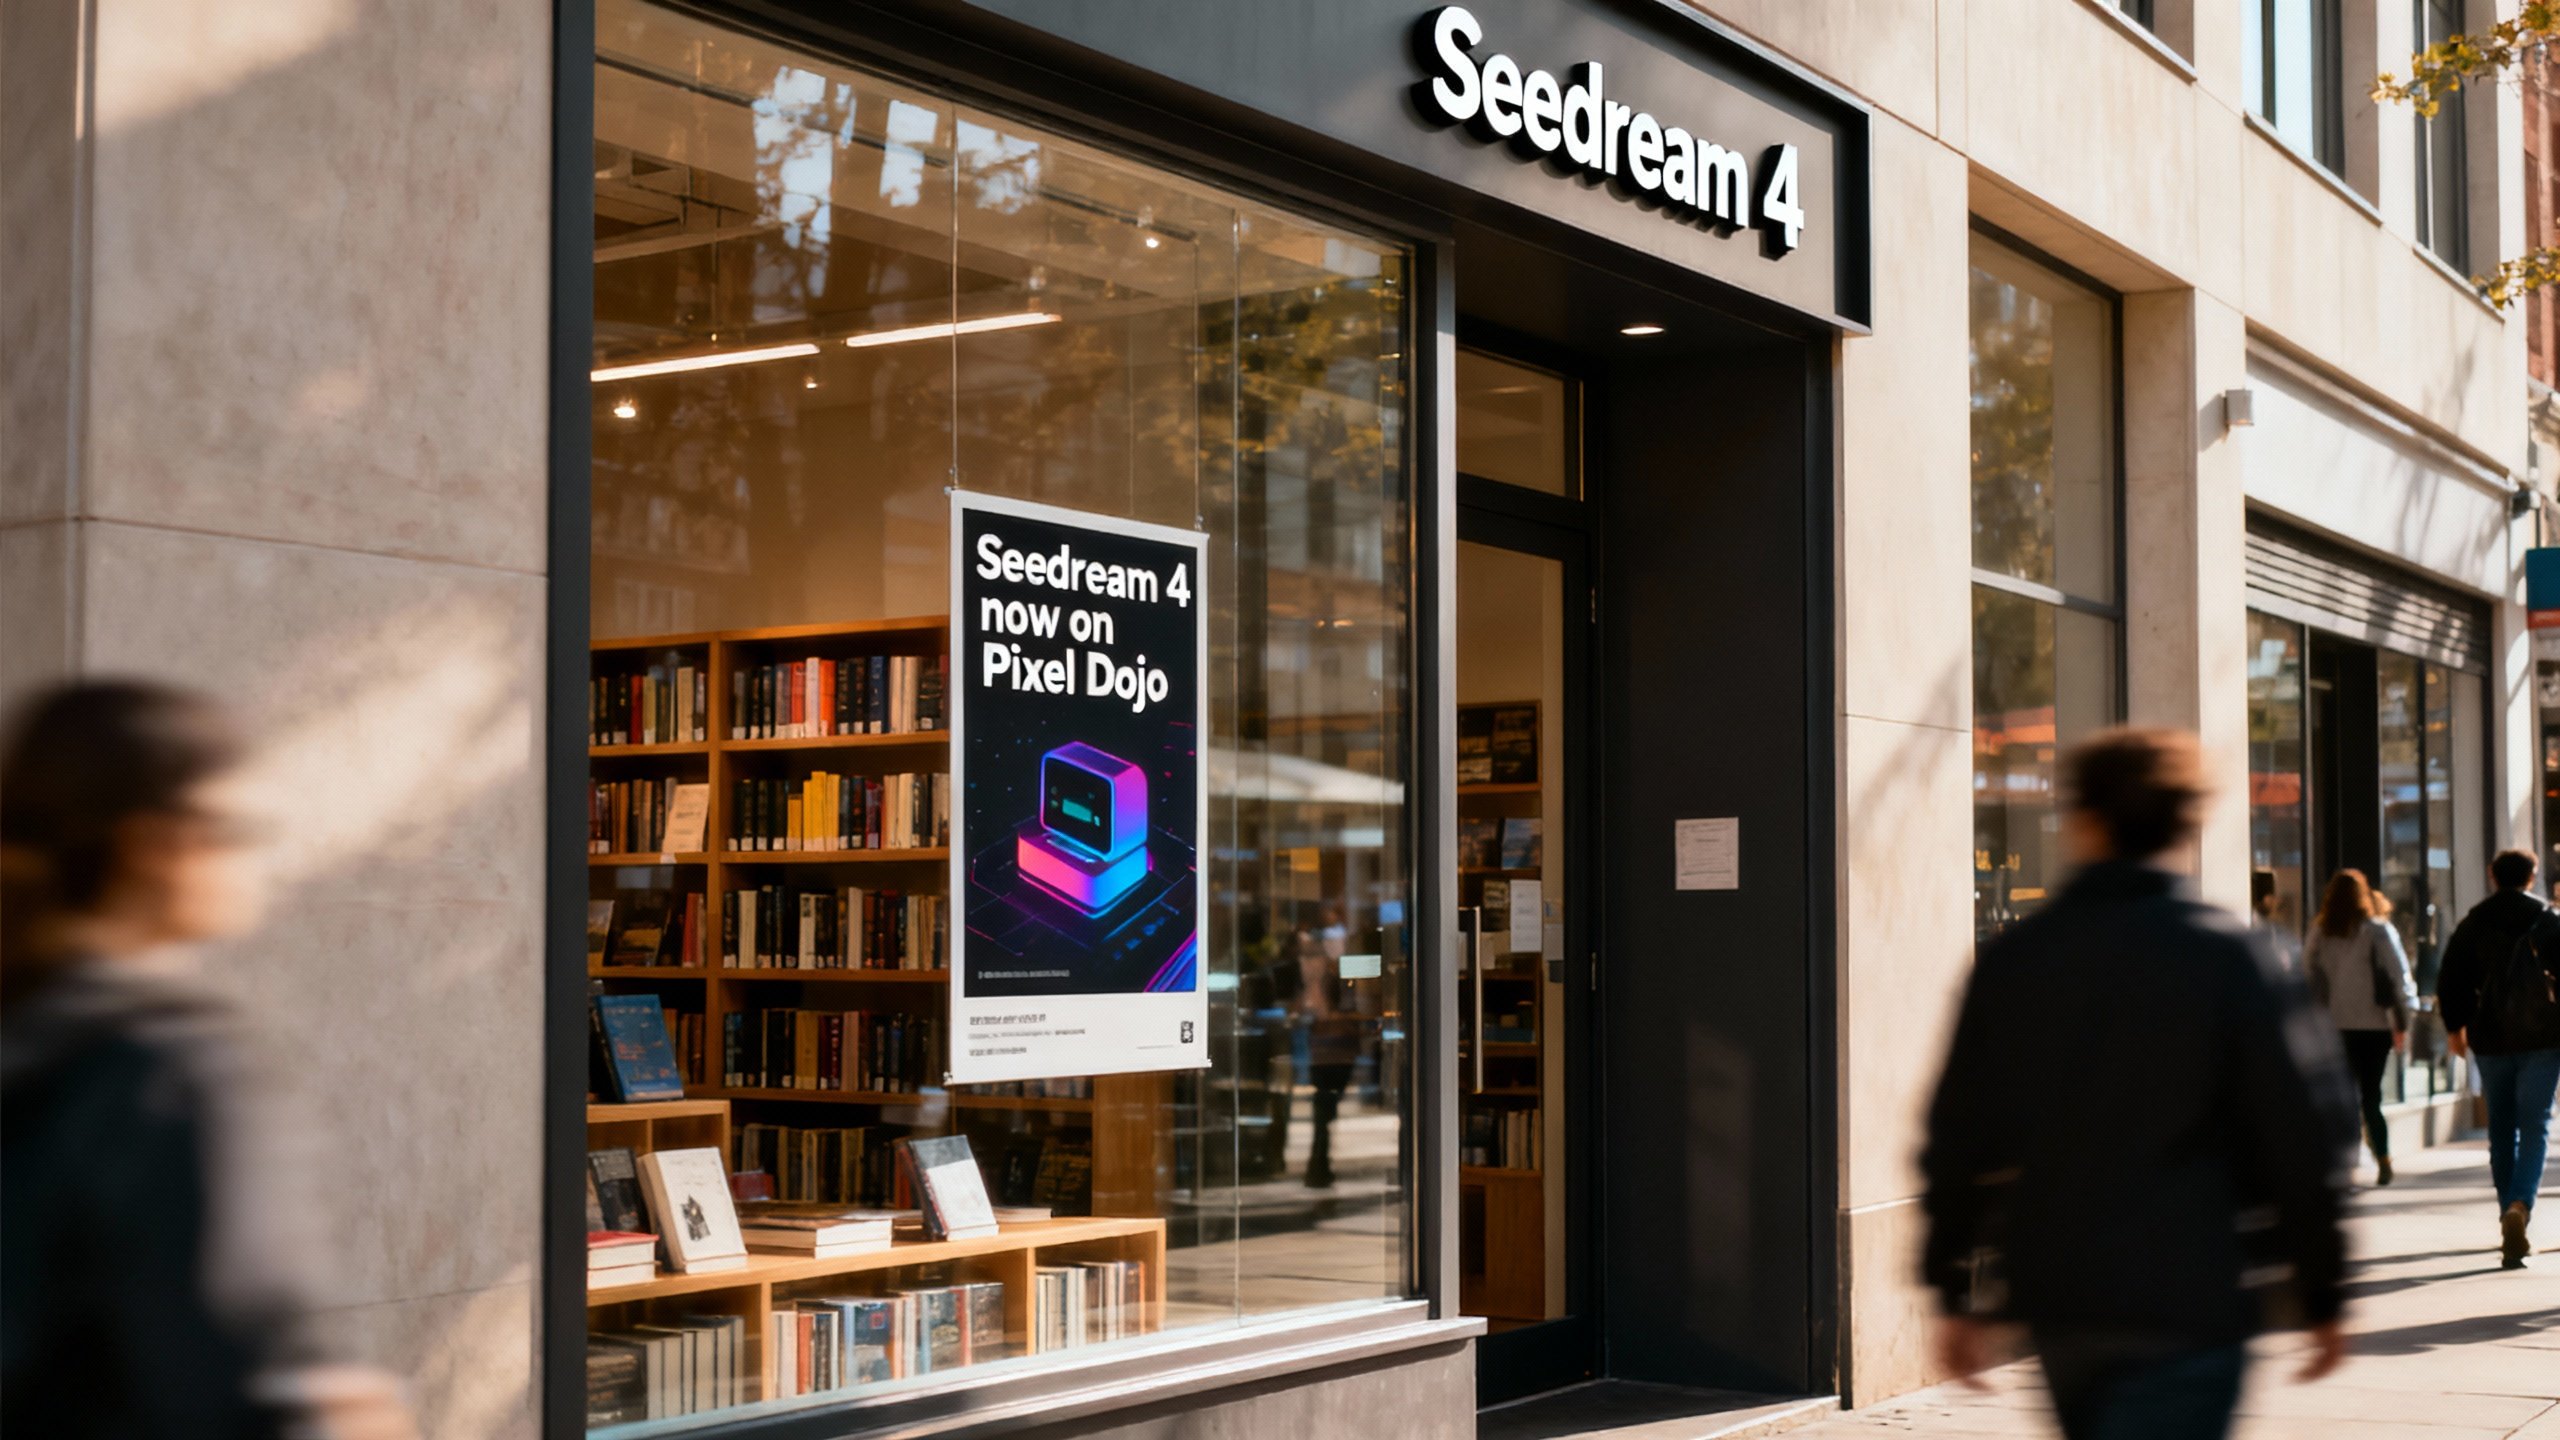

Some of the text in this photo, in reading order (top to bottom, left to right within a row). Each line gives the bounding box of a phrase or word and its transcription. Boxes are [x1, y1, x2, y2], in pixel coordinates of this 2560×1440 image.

[1431, 6, 1804, 249] Seedream 4
[976, 533, 1191, 607] Seedream 4
[981, 597, 1114, 644] now on
[983, 641, 1169, 713] Pixel Dojo
